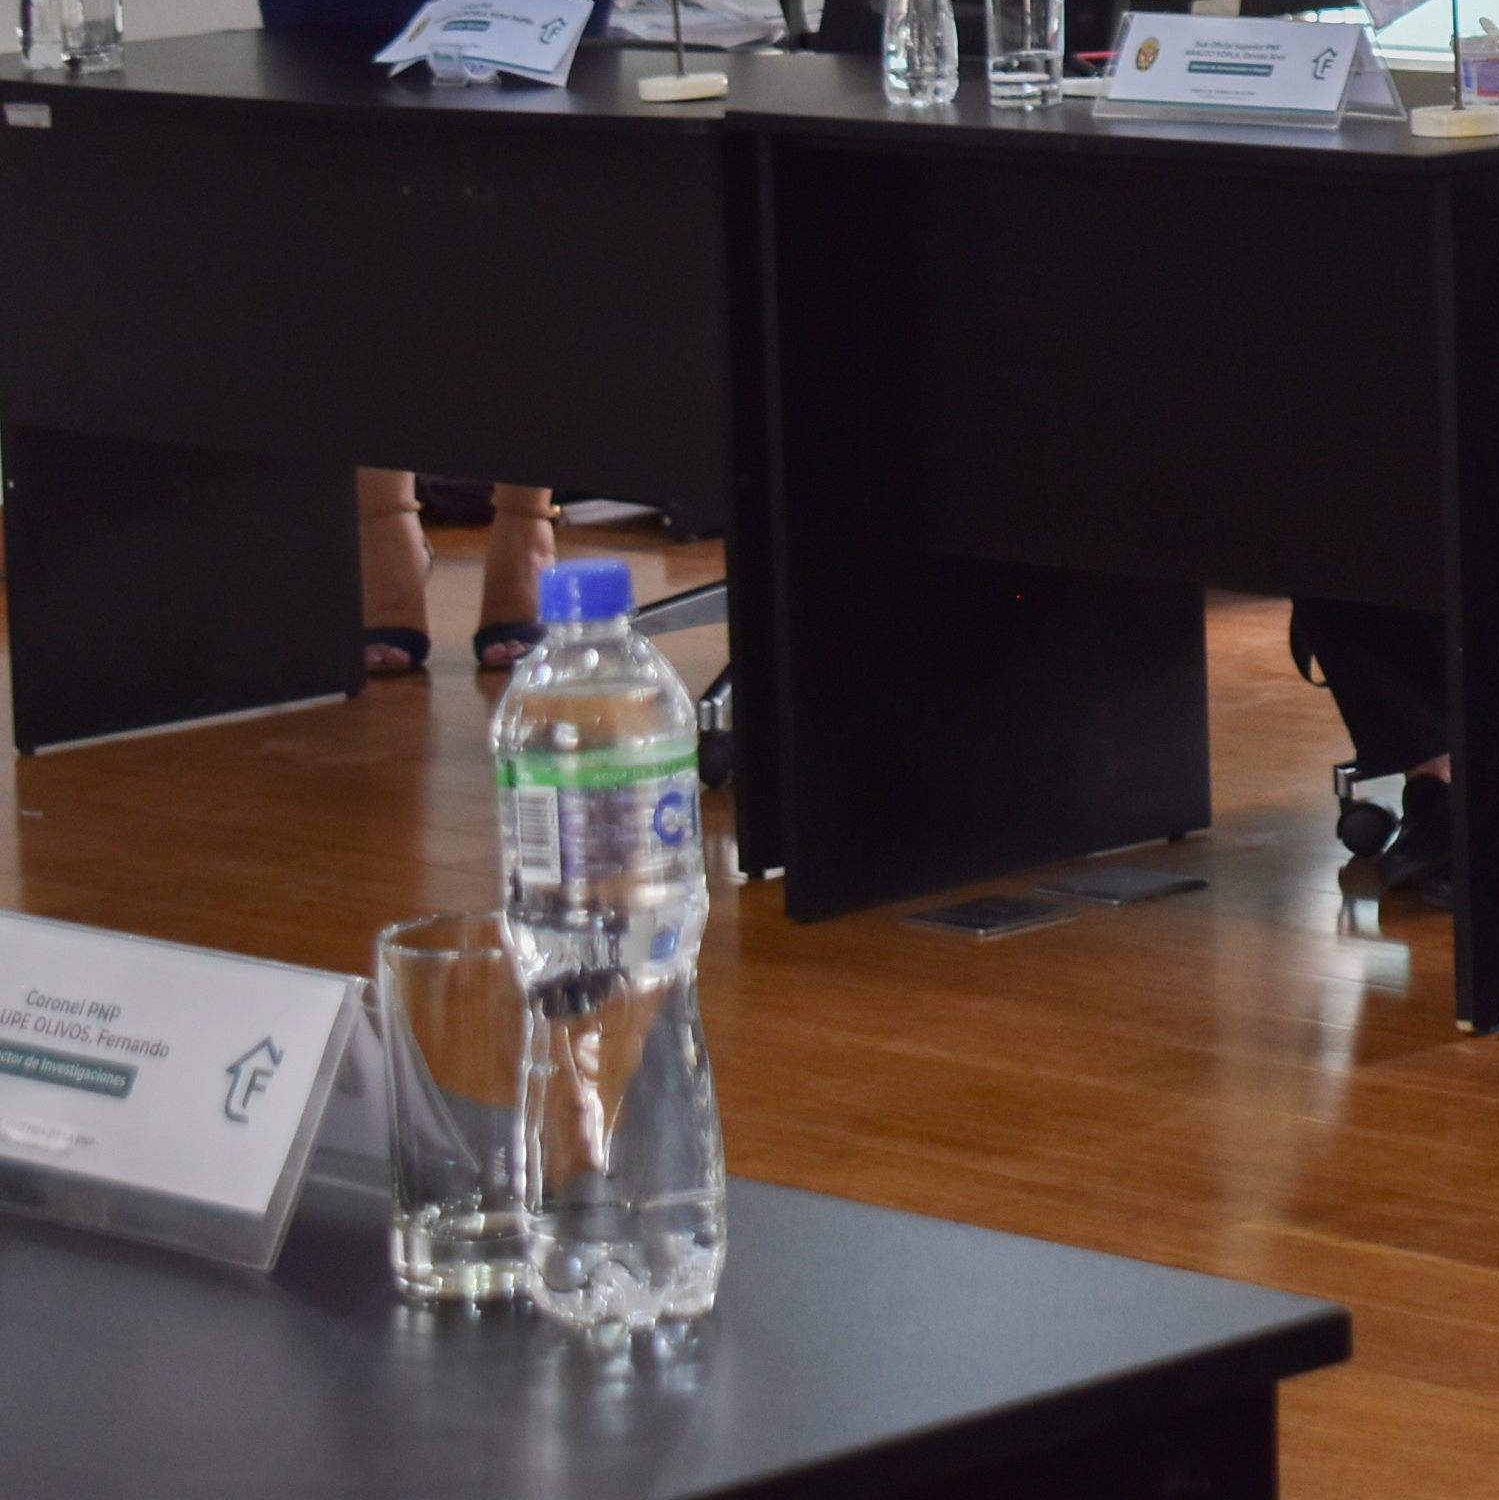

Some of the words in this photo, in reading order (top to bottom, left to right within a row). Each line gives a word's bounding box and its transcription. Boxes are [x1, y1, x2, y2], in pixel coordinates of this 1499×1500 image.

[26, 989, 86, 1016] Coronel
[87, 1001, 122, 1023] PNP
[33, 1015, 94, 1045] OLIVOS,
[97, 1030, 170, 1059] Fernando
[24, 1053, 40, 1067] de
[40, 1055, 127, 1088] Investigaciones
